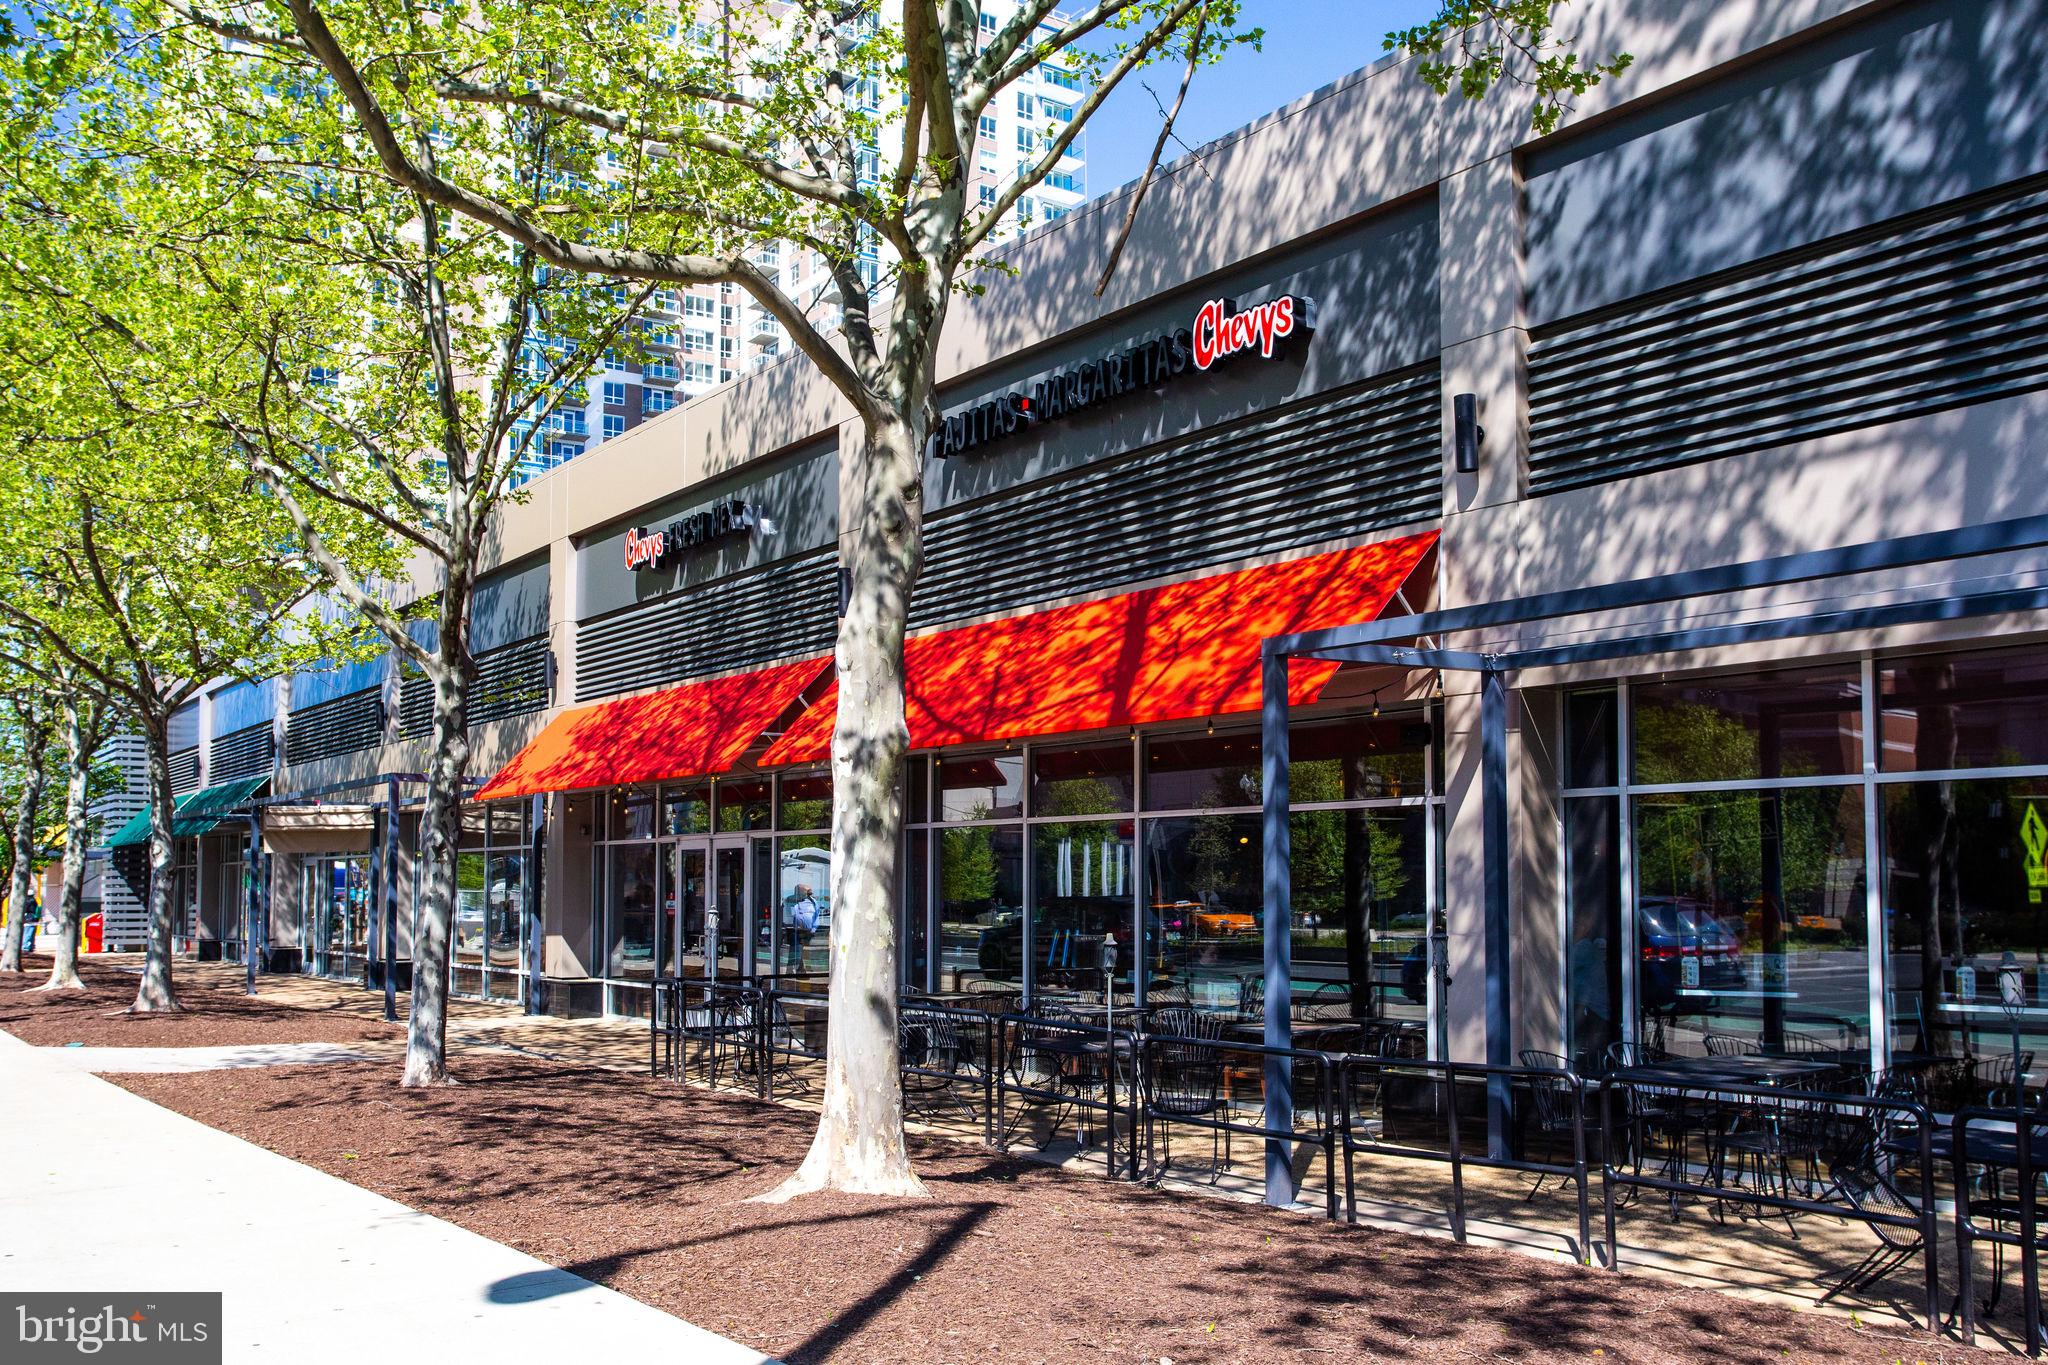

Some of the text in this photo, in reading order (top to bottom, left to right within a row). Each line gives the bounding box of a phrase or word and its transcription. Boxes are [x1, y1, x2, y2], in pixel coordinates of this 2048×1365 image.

[933, 295, 1295, 458] FAJITAS MARGARITAS Chevys
[625, 527, 664, 570] Chevys
[668, 512, 705, 553] FRESH
